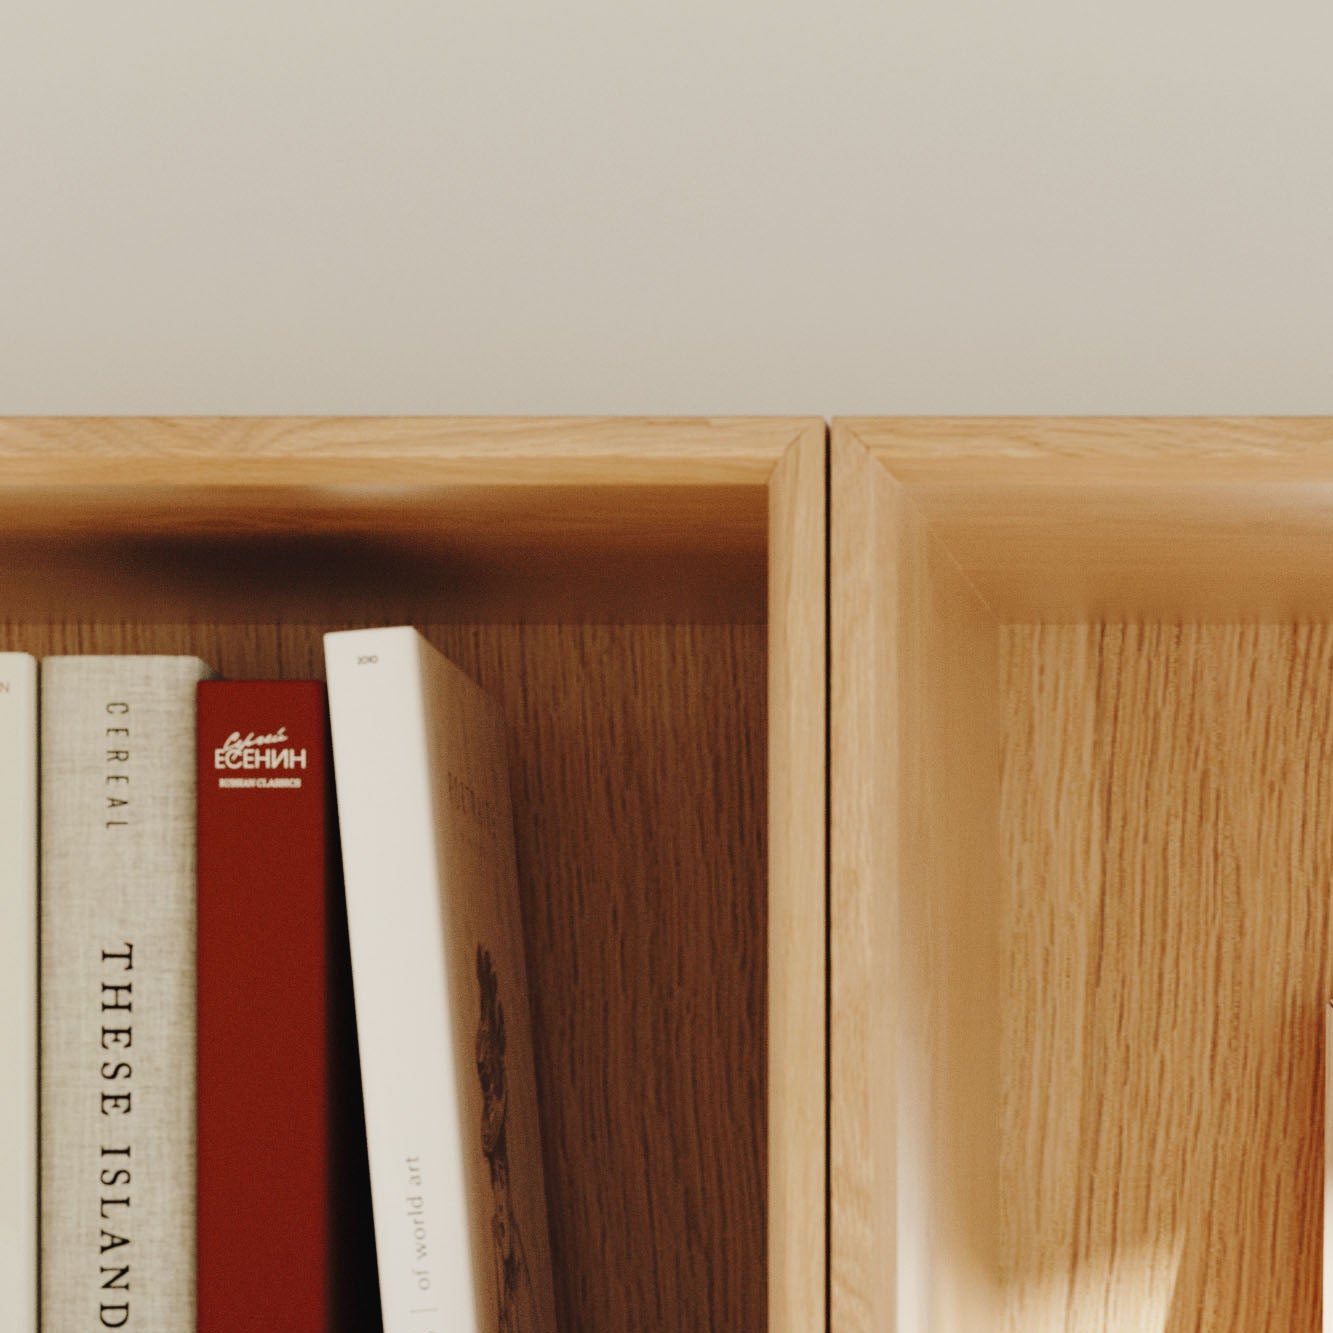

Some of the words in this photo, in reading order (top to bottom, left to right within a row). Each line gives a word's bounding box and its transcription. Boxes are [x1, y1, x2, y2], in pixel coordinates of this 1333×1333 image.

[105, 702, 130, 830] CEREAL
[214, 748, 307, 769] ЕСЕНИН
[101, 942, 134, 1117] THESE
[405, 1155, 421, 1187] art
[406, 1196, 428, 1262] world
[411, 1268, 431, 1292] of
